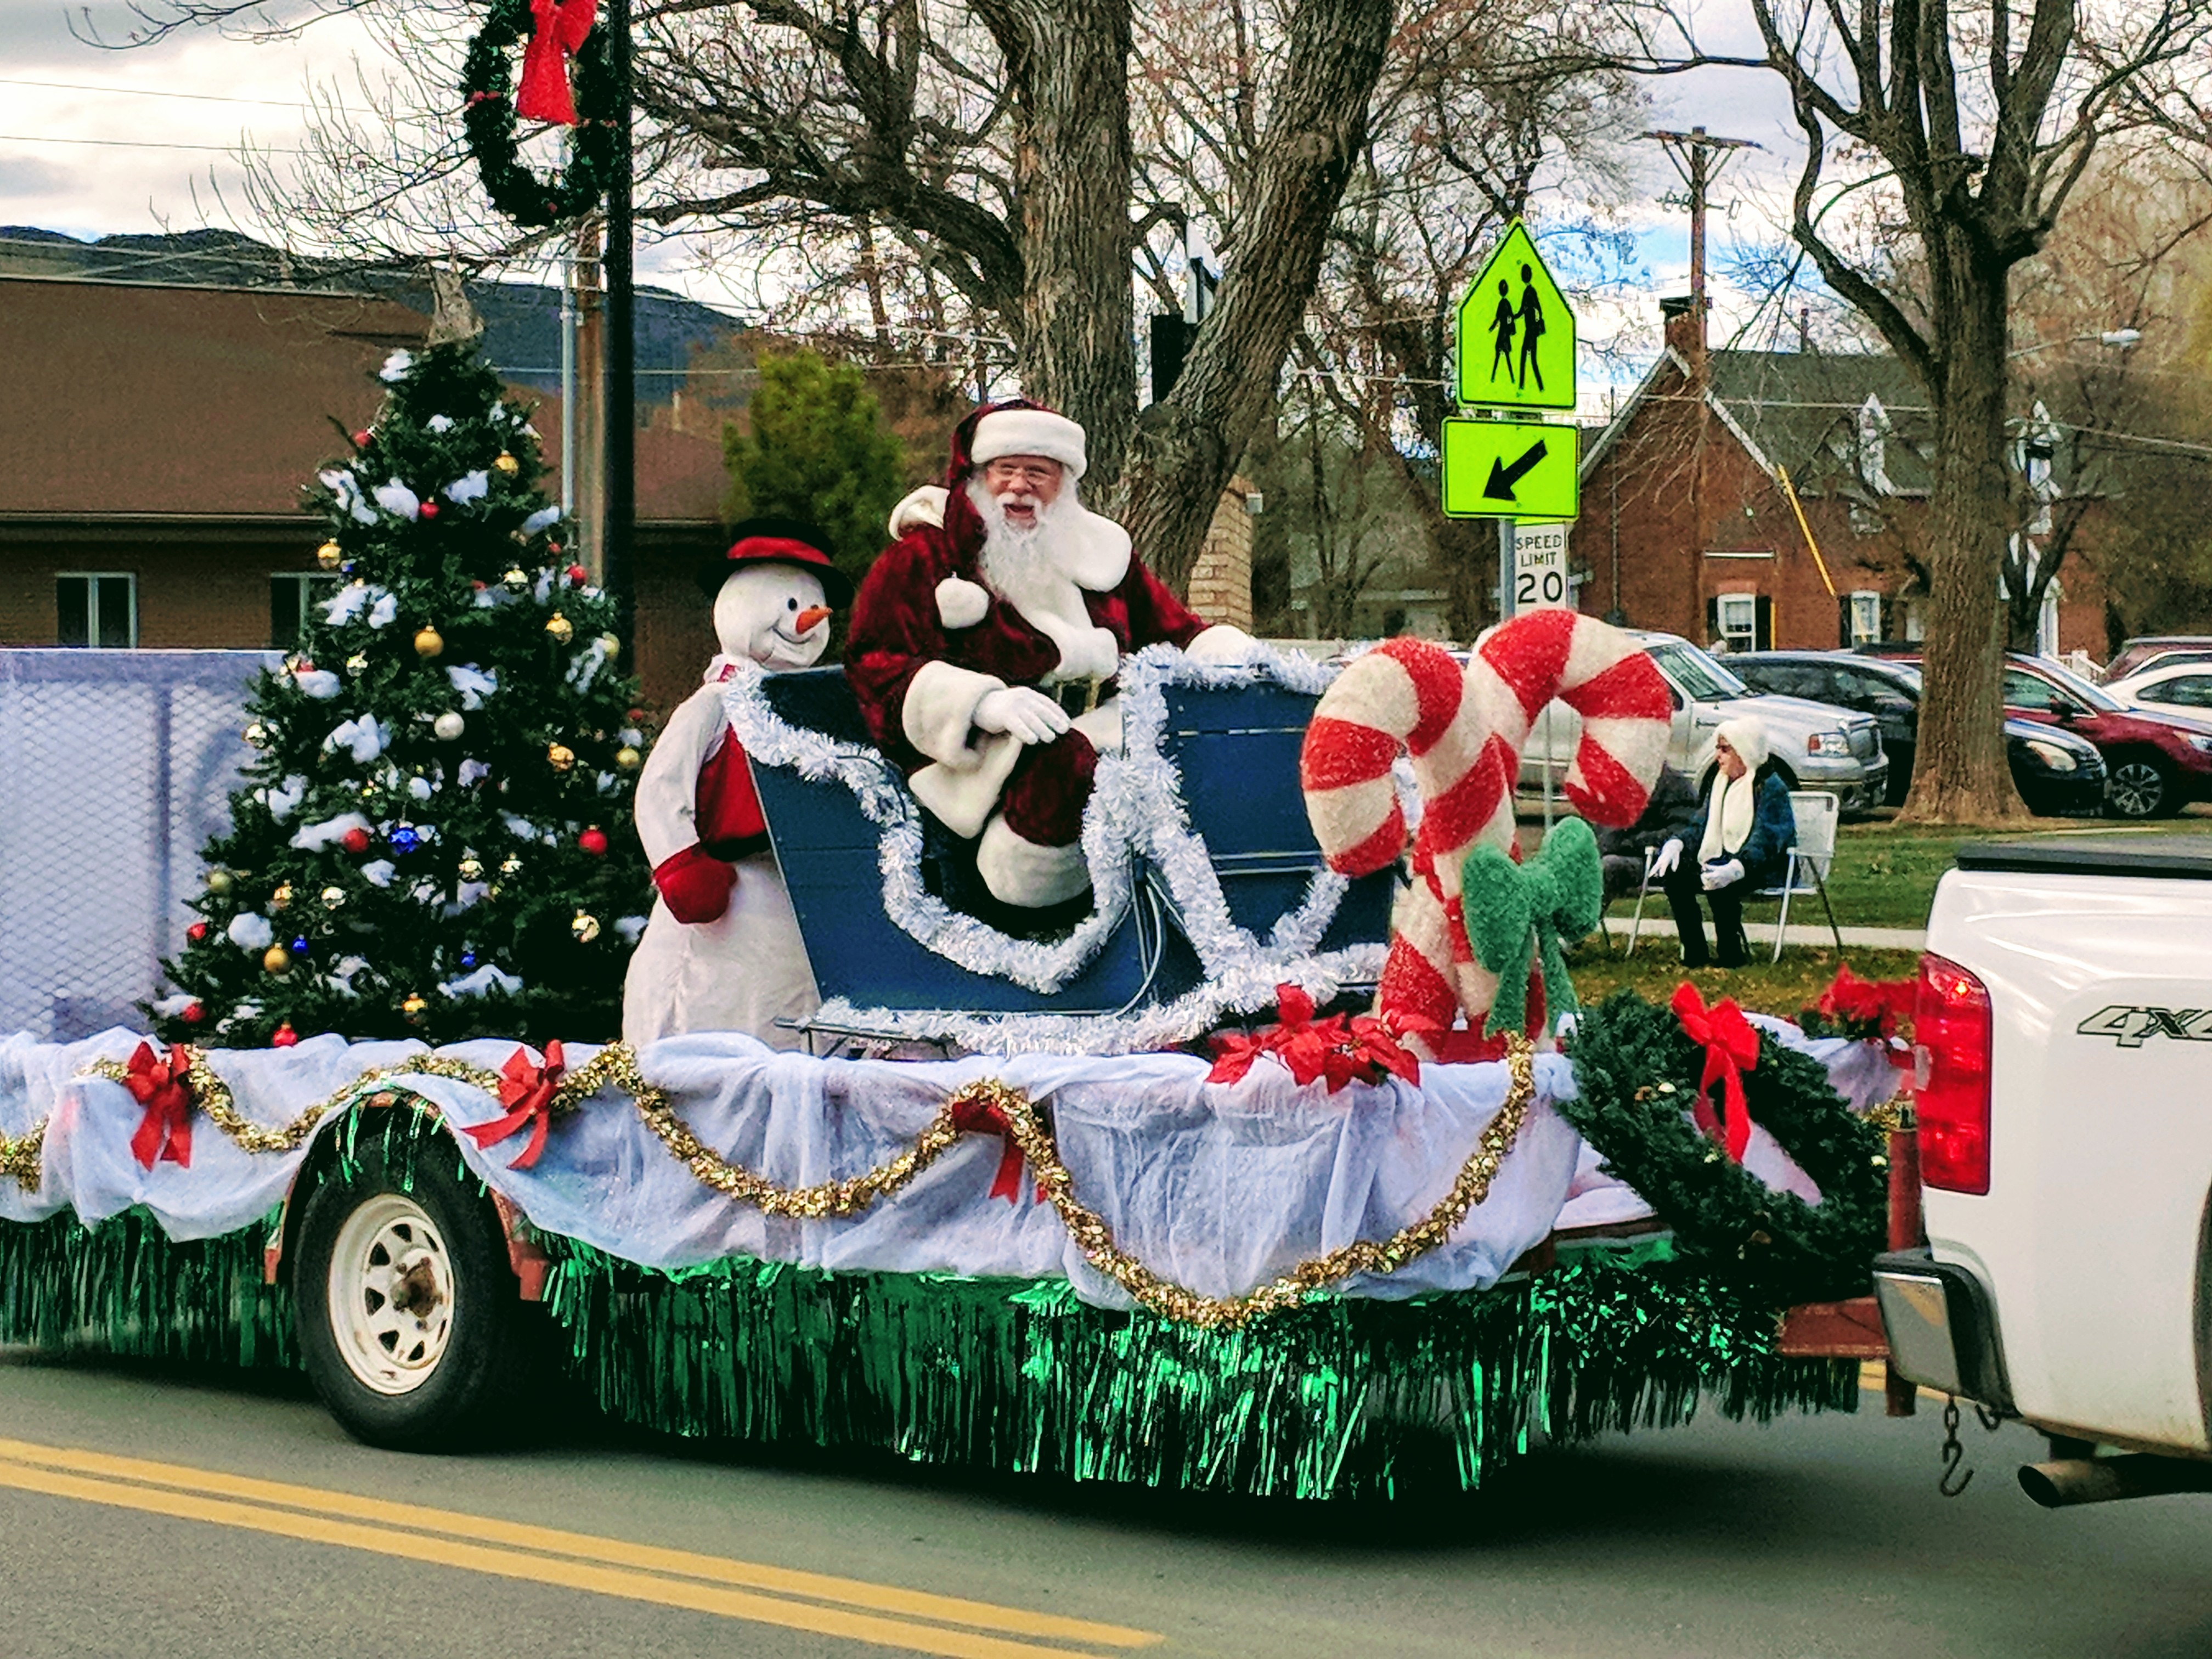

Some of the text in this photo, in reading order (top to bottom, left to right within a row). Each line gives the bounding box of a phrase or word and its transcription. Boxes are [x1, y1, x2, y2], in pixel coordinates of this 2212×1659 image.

[1515, 534, 1562, 550] SPEED
[1521, 551, 1557, 567] LIMIT
[1517, 571, 1563, 604] 20
